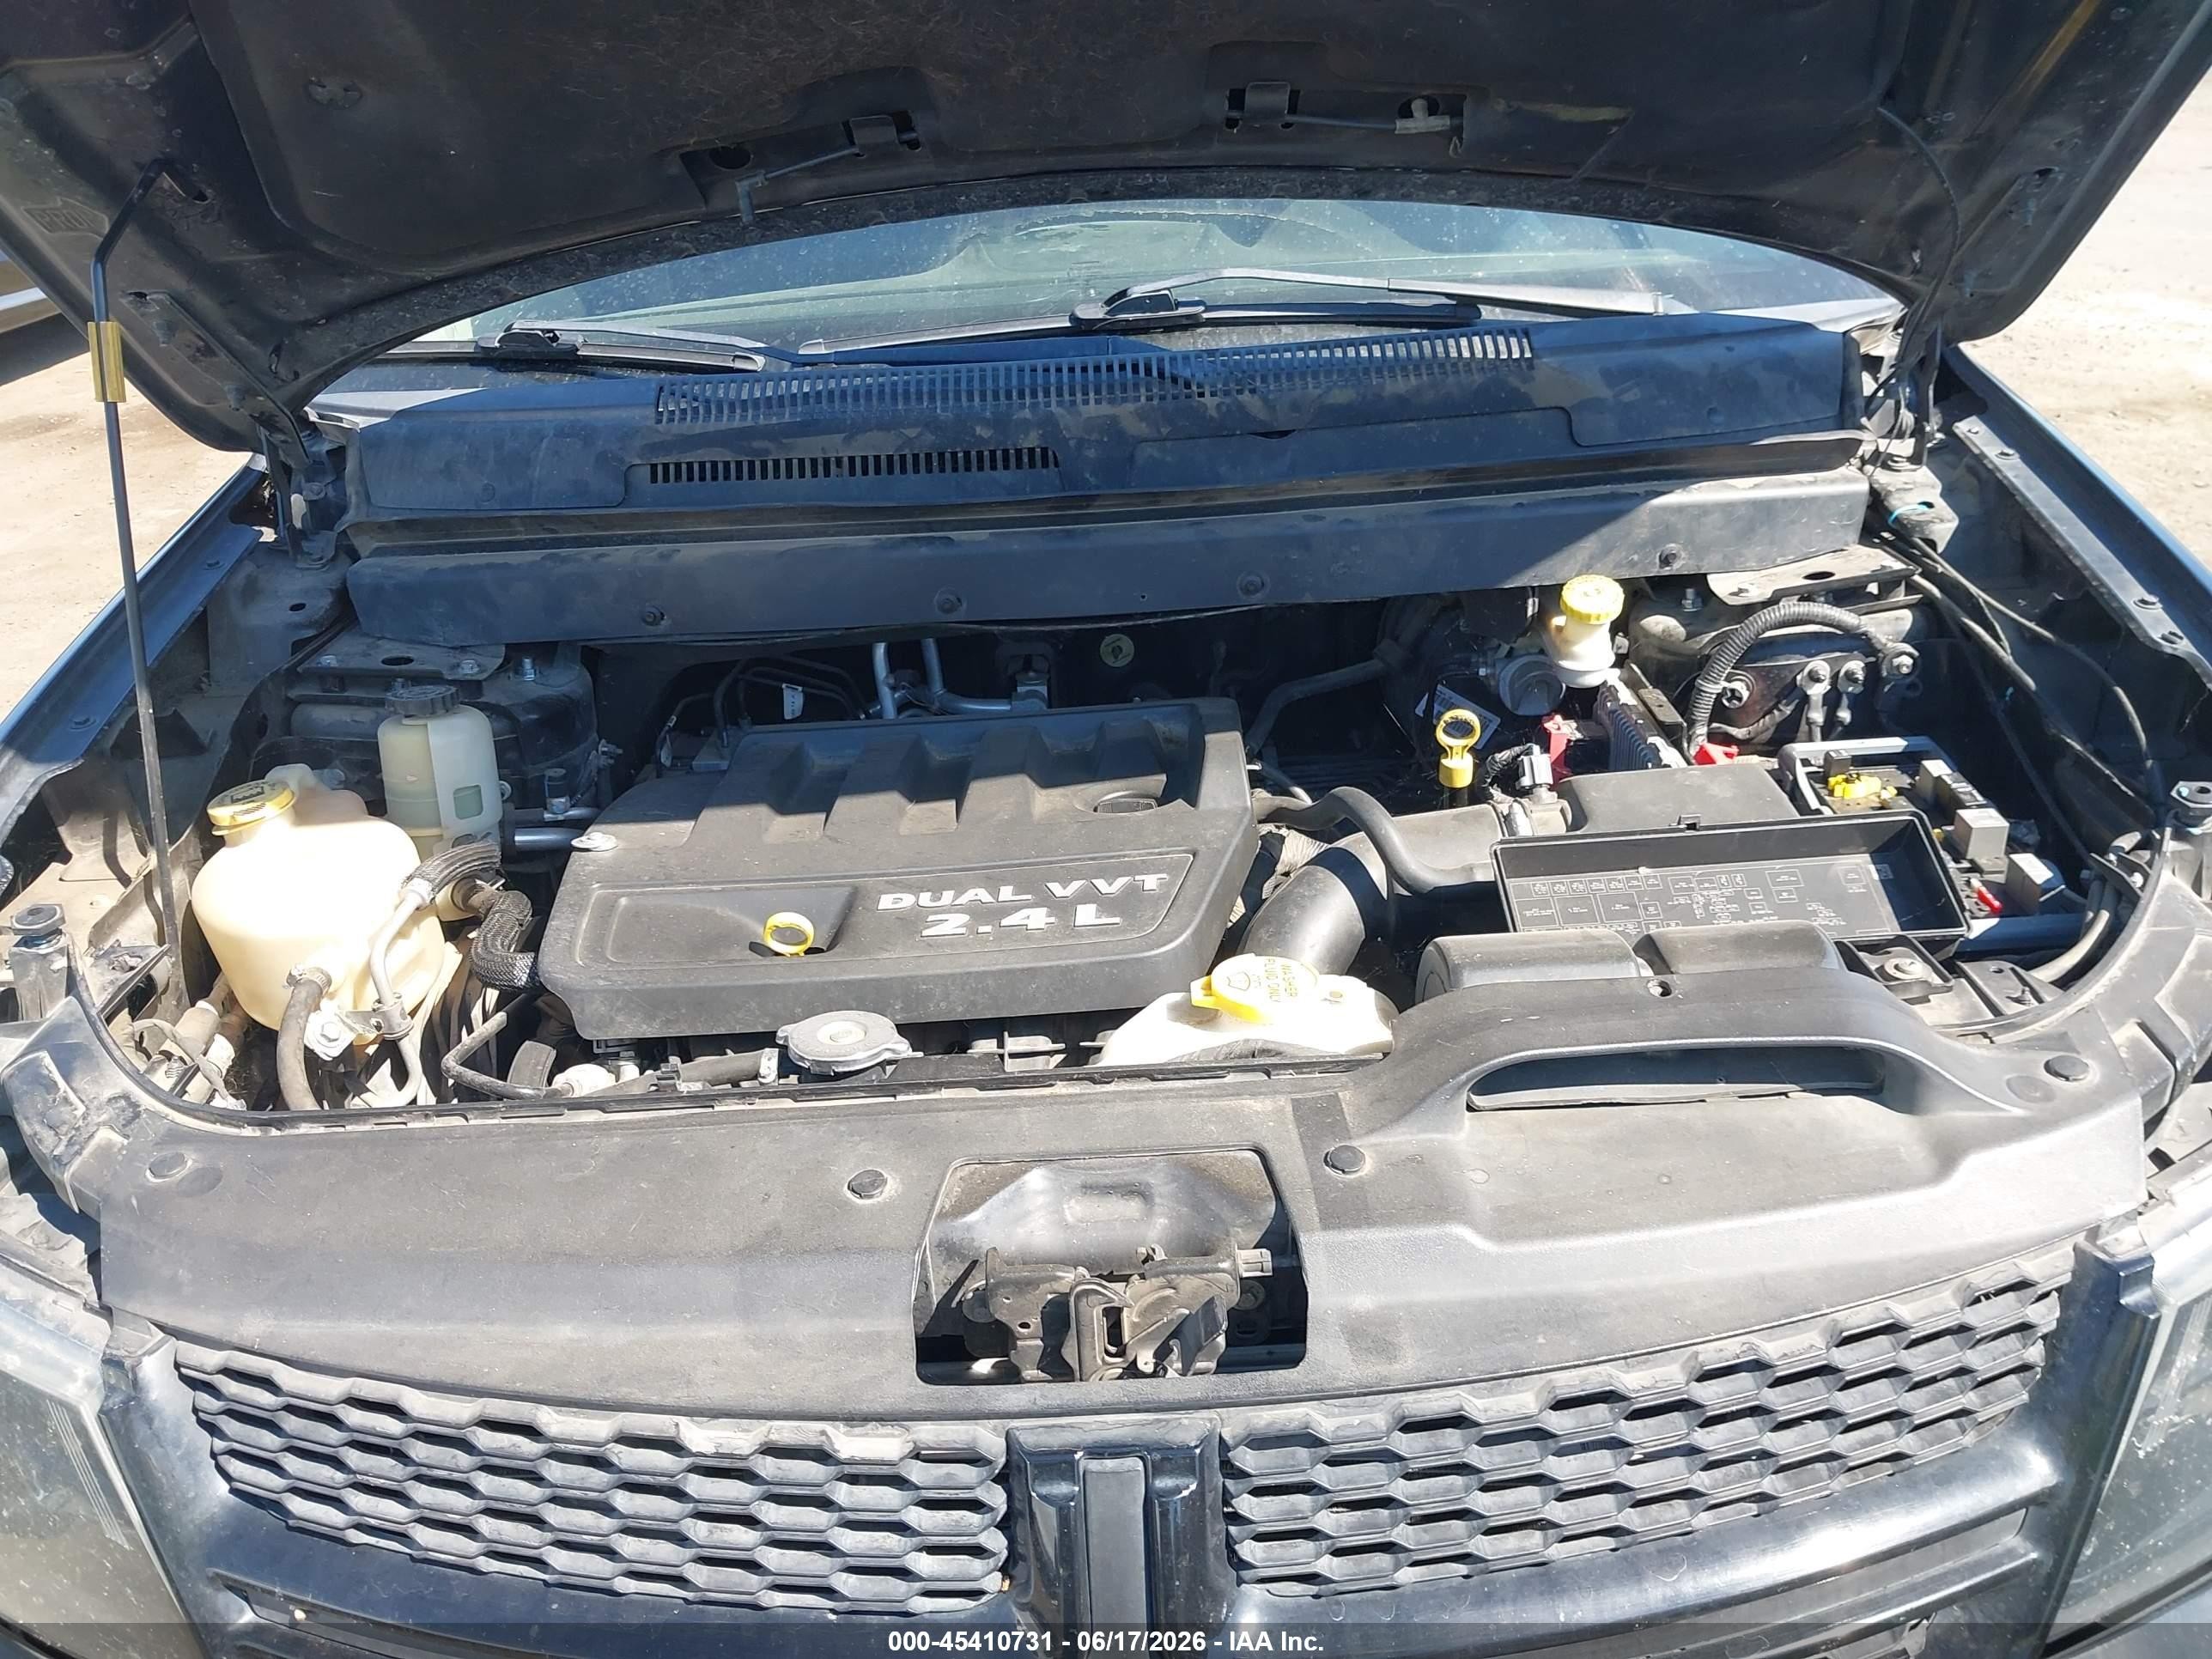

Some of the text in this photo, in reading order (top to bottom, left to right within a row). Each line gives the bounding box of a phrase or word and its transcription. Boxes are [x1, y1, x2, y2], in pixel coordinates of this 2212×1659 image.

[876, 873, 1169, 911] DUAL VVT
[920, 903, 1121, 938] 2.4 L
[1265, 958, 1281, 1003] FLUID ONLY
